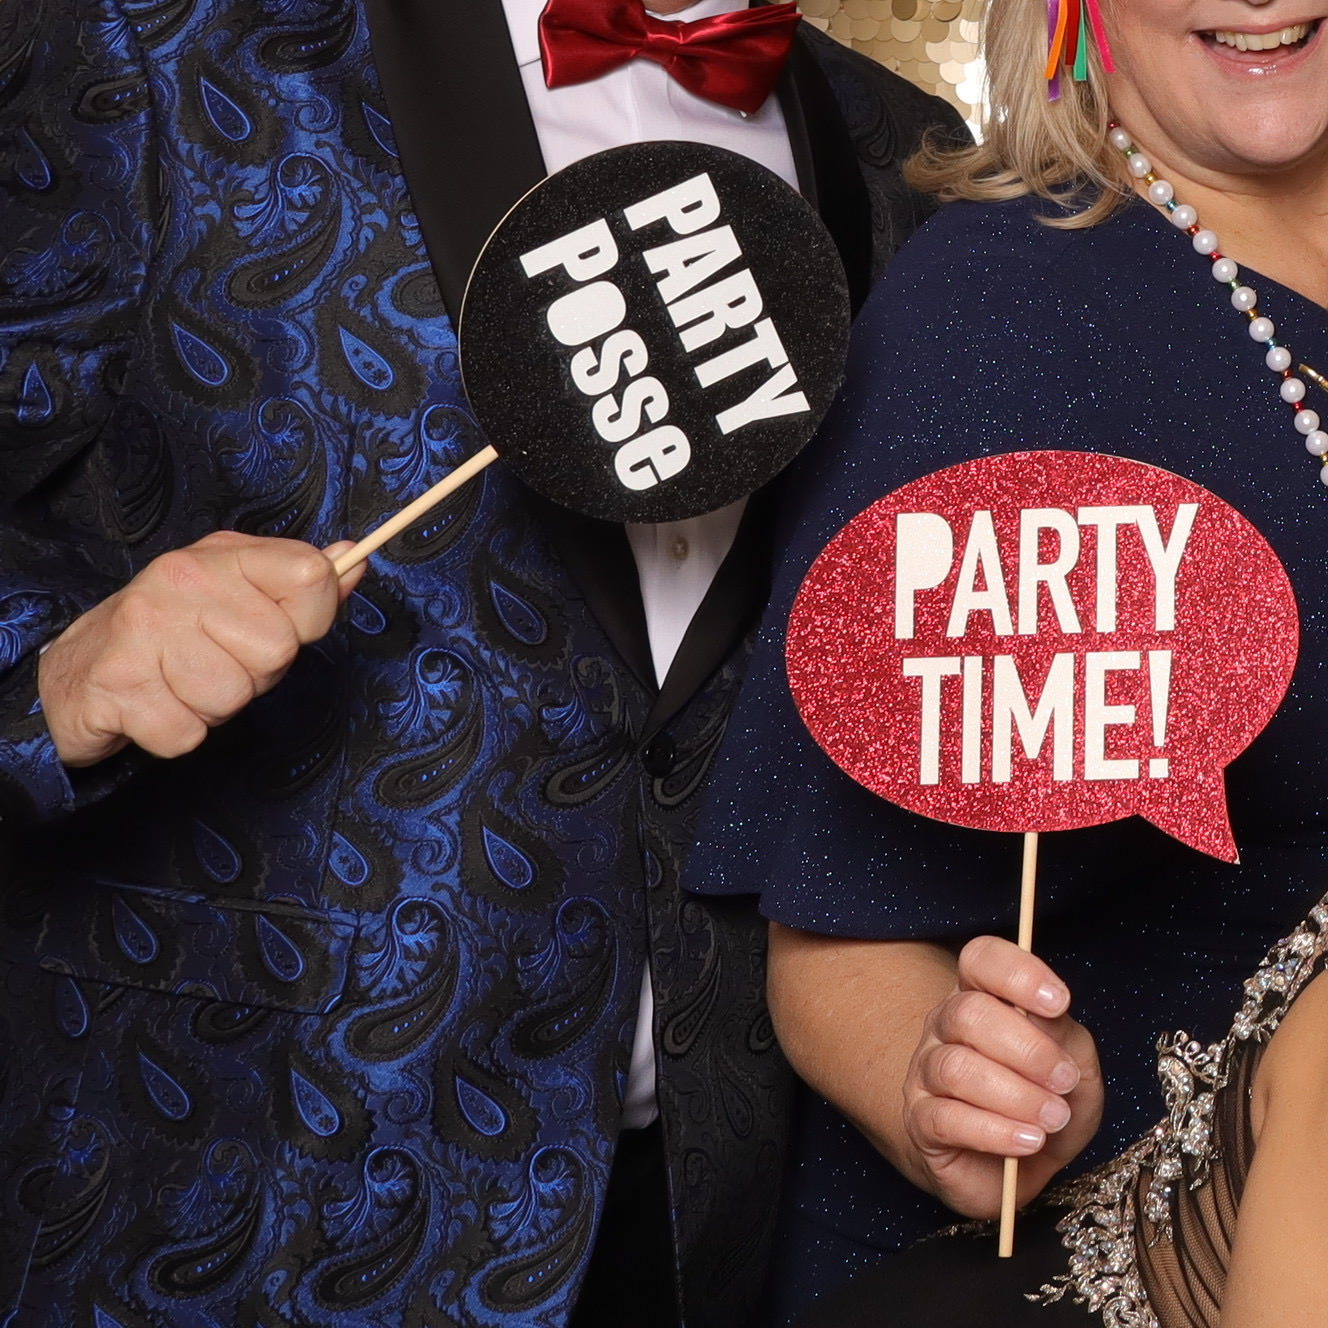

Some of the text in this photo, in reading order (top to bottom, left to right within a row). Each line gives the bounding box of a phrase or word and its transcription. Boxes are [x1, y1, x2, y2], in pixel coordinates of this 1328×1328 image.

[623, 172, 811, 435] PARTY
[894, 503, 1199, 639] PARTY
[903, 649, 1172, 785] TIME!
